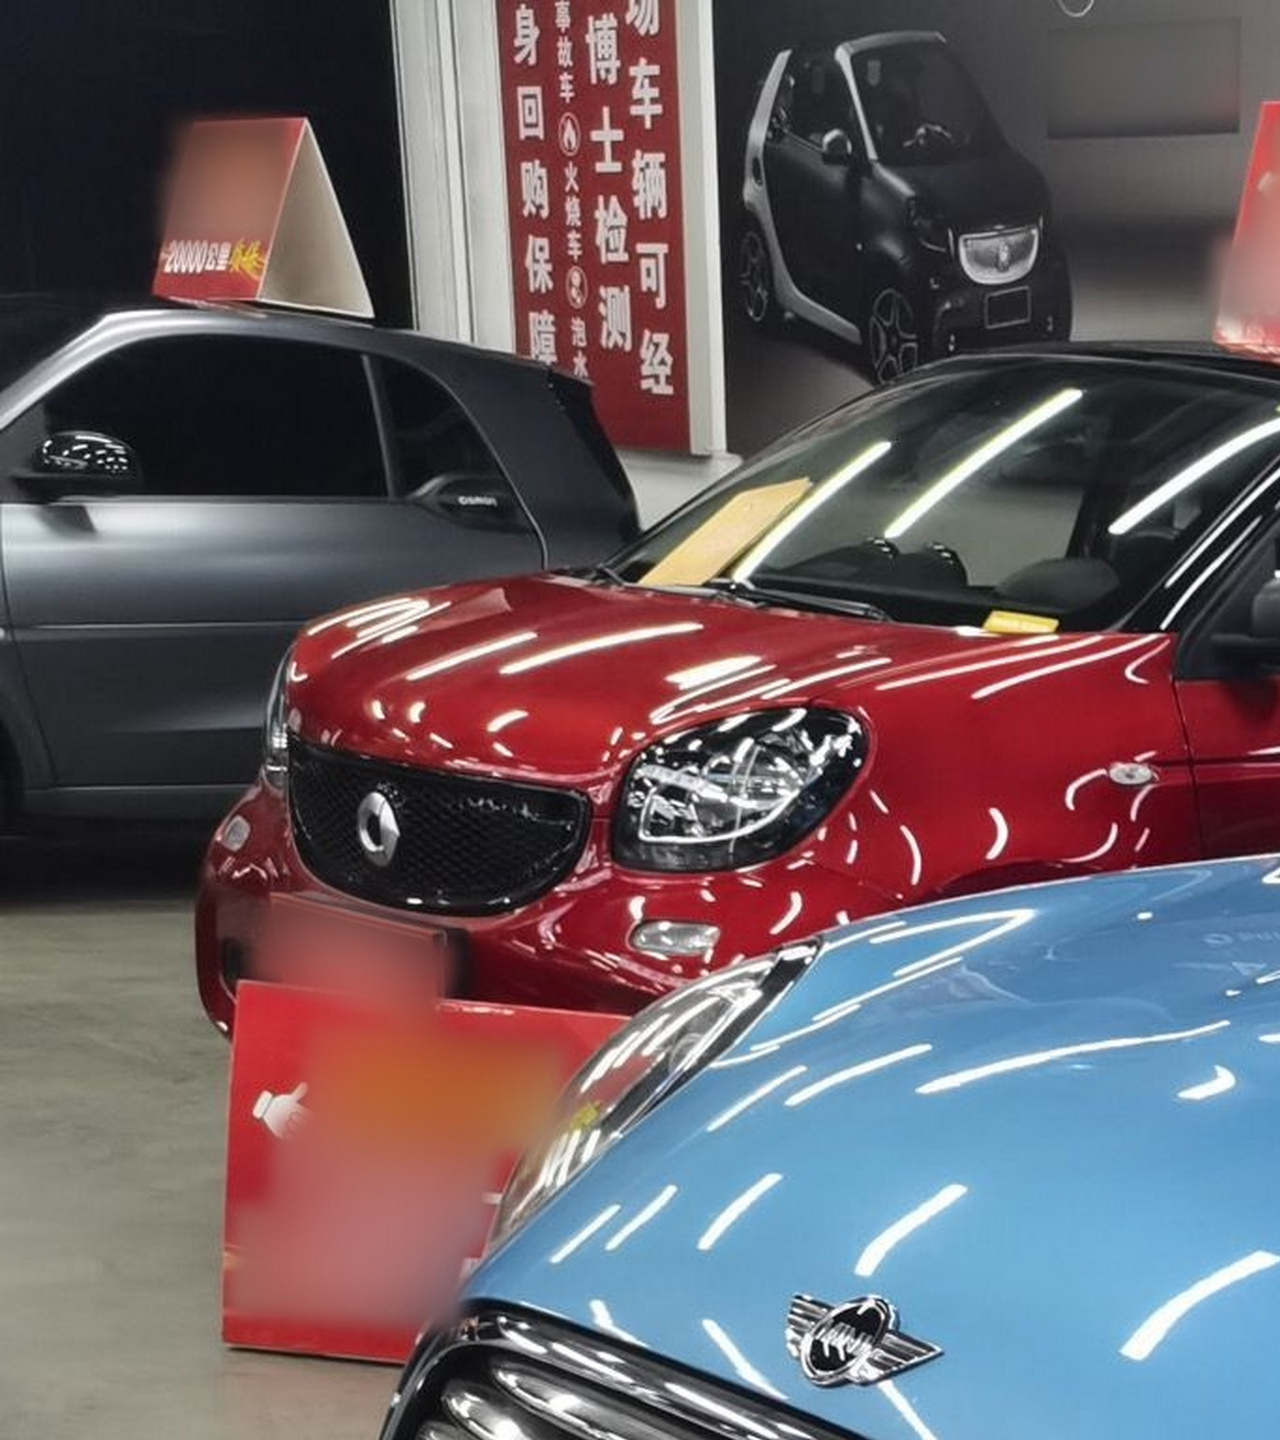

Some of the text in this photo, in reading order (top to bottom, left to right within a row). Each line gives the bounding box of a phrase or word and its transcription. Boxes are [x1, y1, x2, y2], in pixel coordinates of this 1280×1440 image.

[513, 3, 558, 366] 身回购保障
[585, 12, 632, 353] 博士检测
